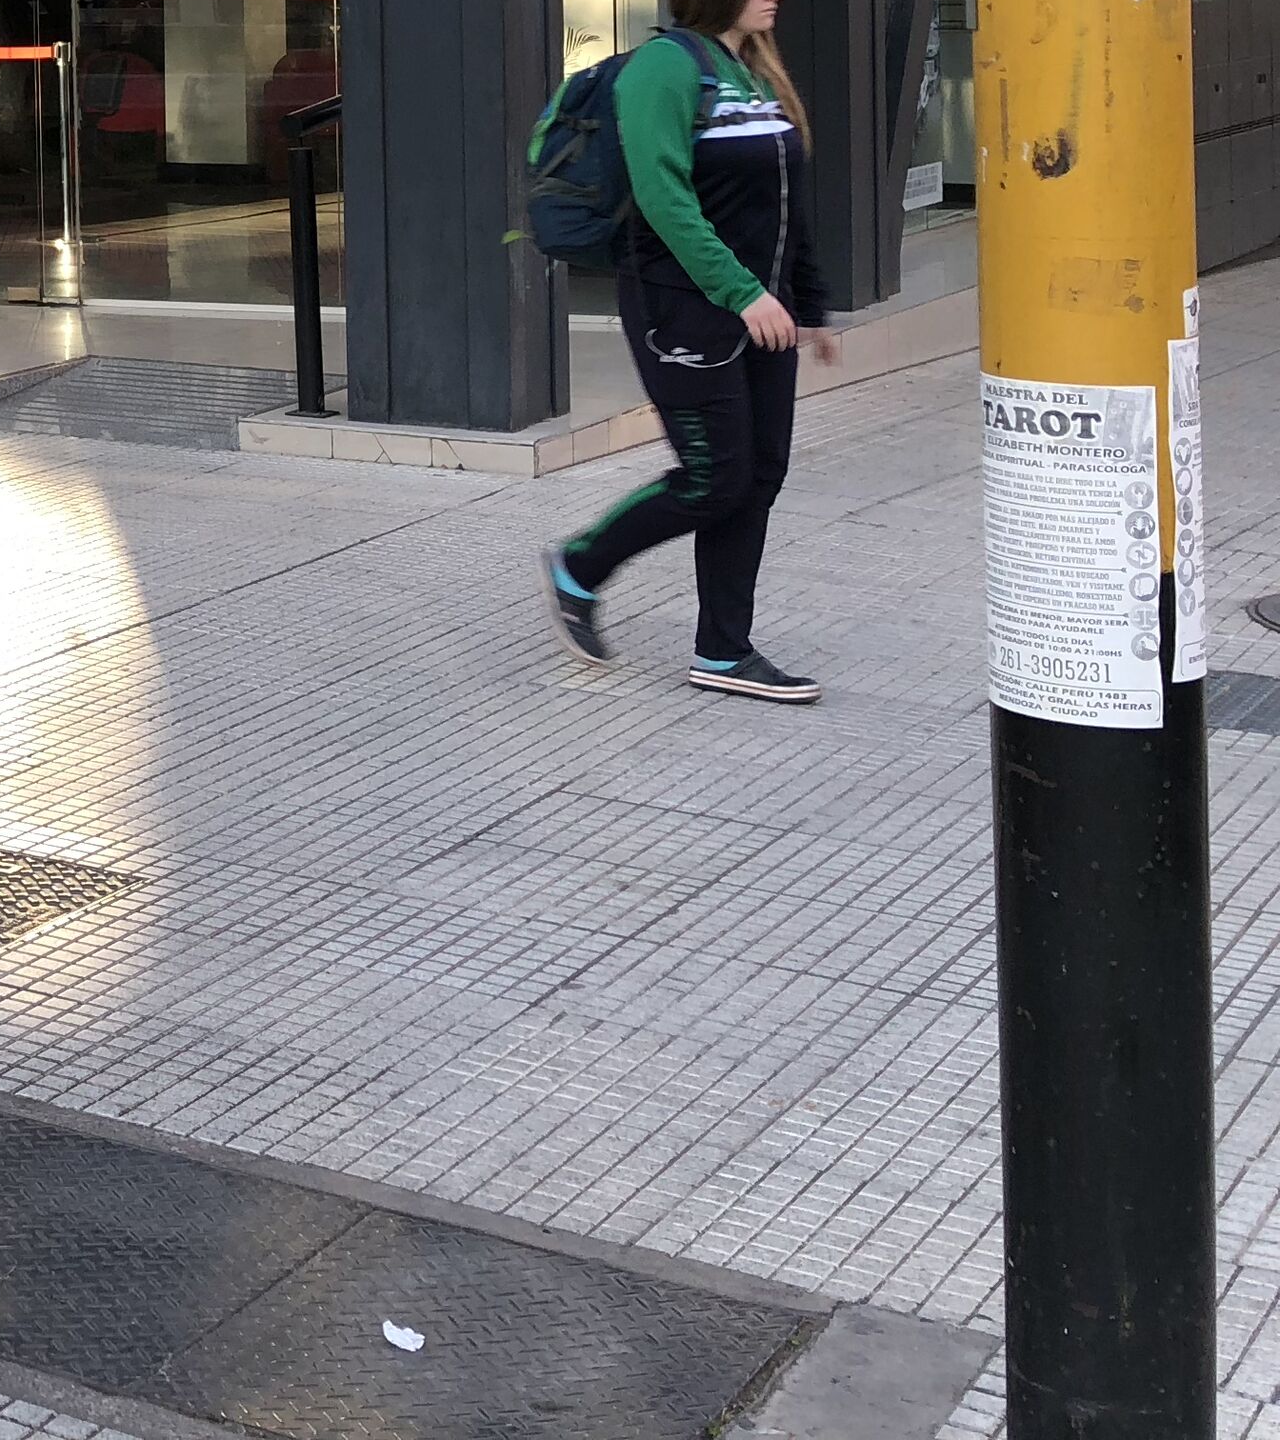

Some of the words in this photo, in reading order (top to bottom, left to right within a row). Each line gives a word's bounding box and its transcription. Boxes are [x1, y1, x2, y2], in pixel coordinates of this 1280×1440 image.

[985, 383, 1048, 403] MAESTRA
[1052, 392, 1089, 406] DEL
[983, 399, 1103, 439] TAROT
[988, 435, 1043, 454] ELIZABETH
[1046, 444, 1125, 459] MONTERO
[995, 453, 1046, 469] ESPIRITUAL
[1053, 462, 1147, 474] PARASICOLOGA
[1107, 480, 1117, 488] LA
[1053, 625, 1105, 635] AYUDARLE
[1066, 616, 1103, 626] MAYOR
[1021, 628, 1050, 642] TODOS
[1051, 636, 1069, 645] LOS
[1074, 646, 1083, 655] A
[999, 646, 1112, 684] 261-3905231
[1025, 681, 1058, 694] CALLE
[999, 694, 1043, 711] MENDOZA
[1050, 706, 1098, 718] CIUDAD
[1038, 693, 1046, 701] Y
[1086, 700, 1111, 709] LAS
[1112, 702, 1153, 712] HERAS
